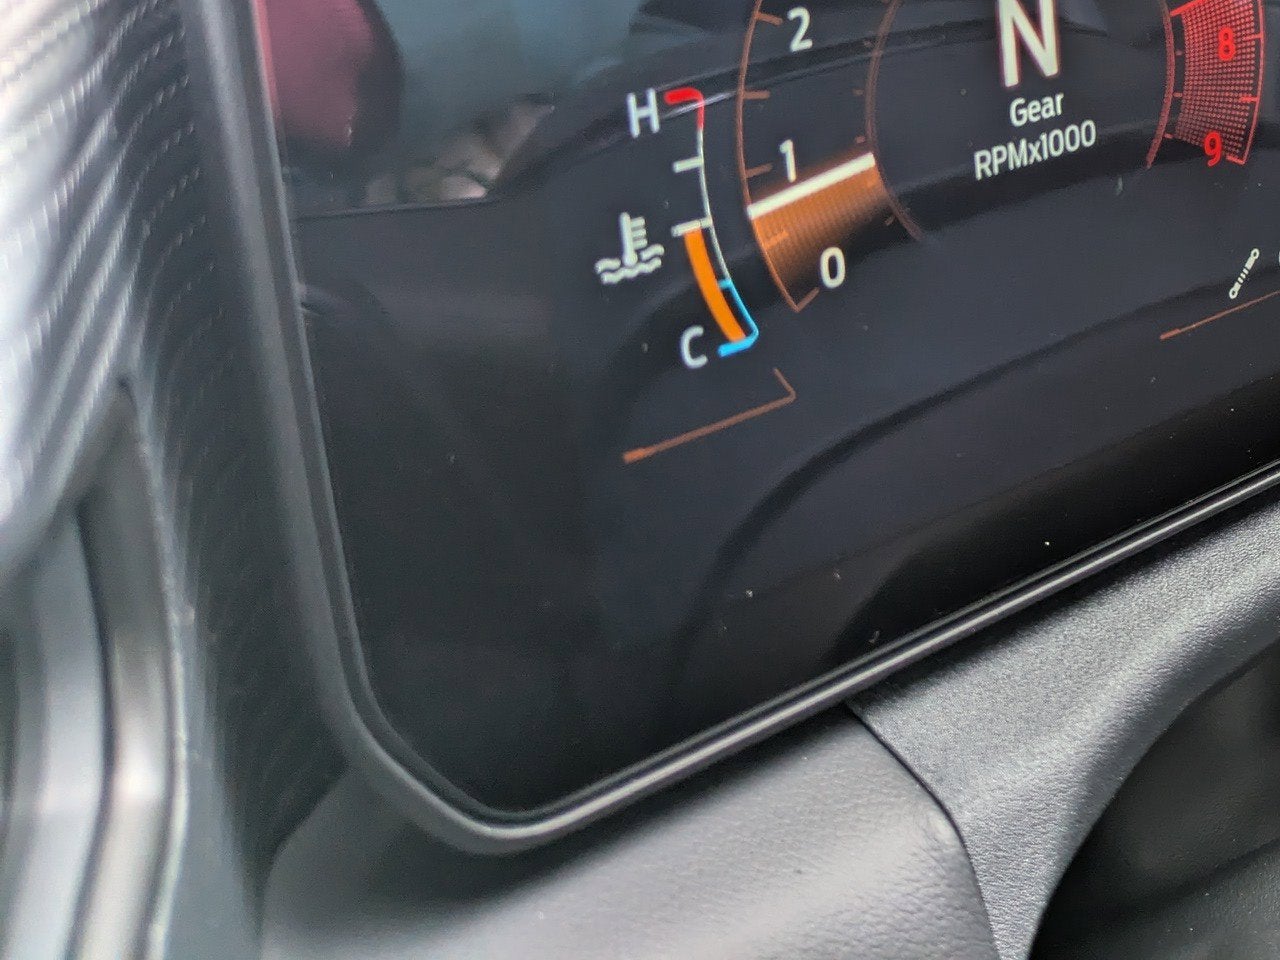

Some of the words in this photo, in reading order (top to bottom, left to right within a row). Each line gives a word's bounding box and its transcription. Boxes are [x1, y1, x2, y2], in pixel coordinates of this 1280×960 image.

[788, 8, 813, 53] 2
[1217, 28, 1236, 61] 8
[628, 88, 660, 135] H
[1011, 92, 1064, 127] Gear
[781, 141, 797, 181] 1
[974, 120, 1097, 181] RPMx1000
[1205, 131, 1223, 167] 9
[821, 248, 846, 288] 0
[681, 327, 706, 368] C
